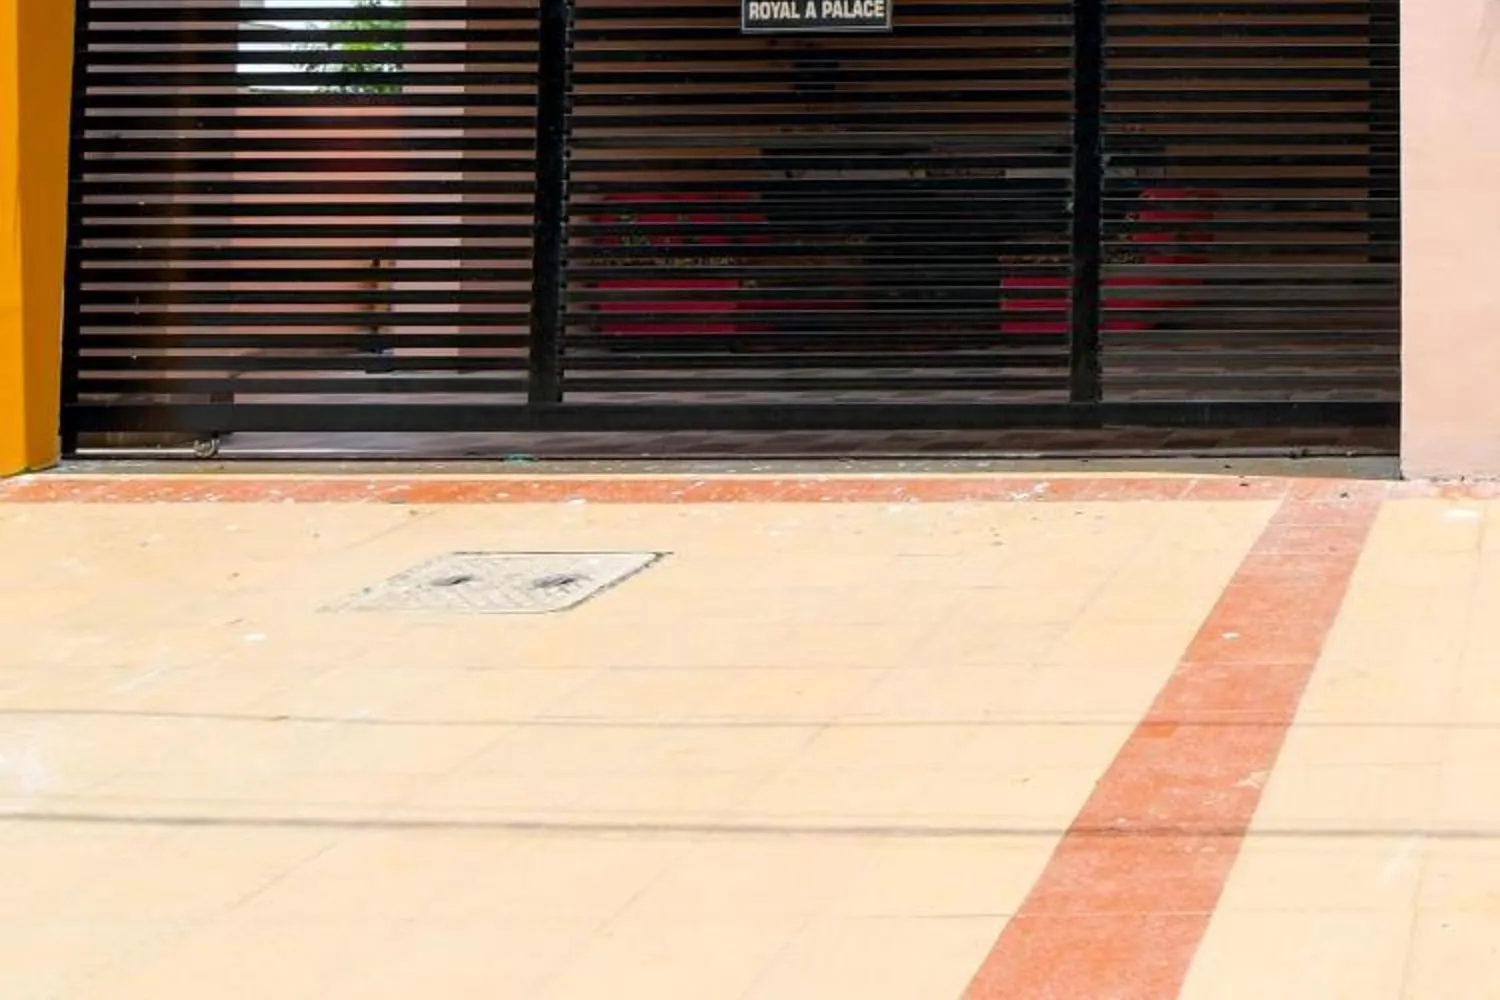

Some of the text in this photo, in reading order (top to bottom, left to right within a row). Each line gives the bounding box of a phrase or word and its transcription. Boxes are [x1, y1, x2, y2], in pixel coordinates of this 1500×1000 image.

[749, 0, 885, 20] ROYAL A PALACE
